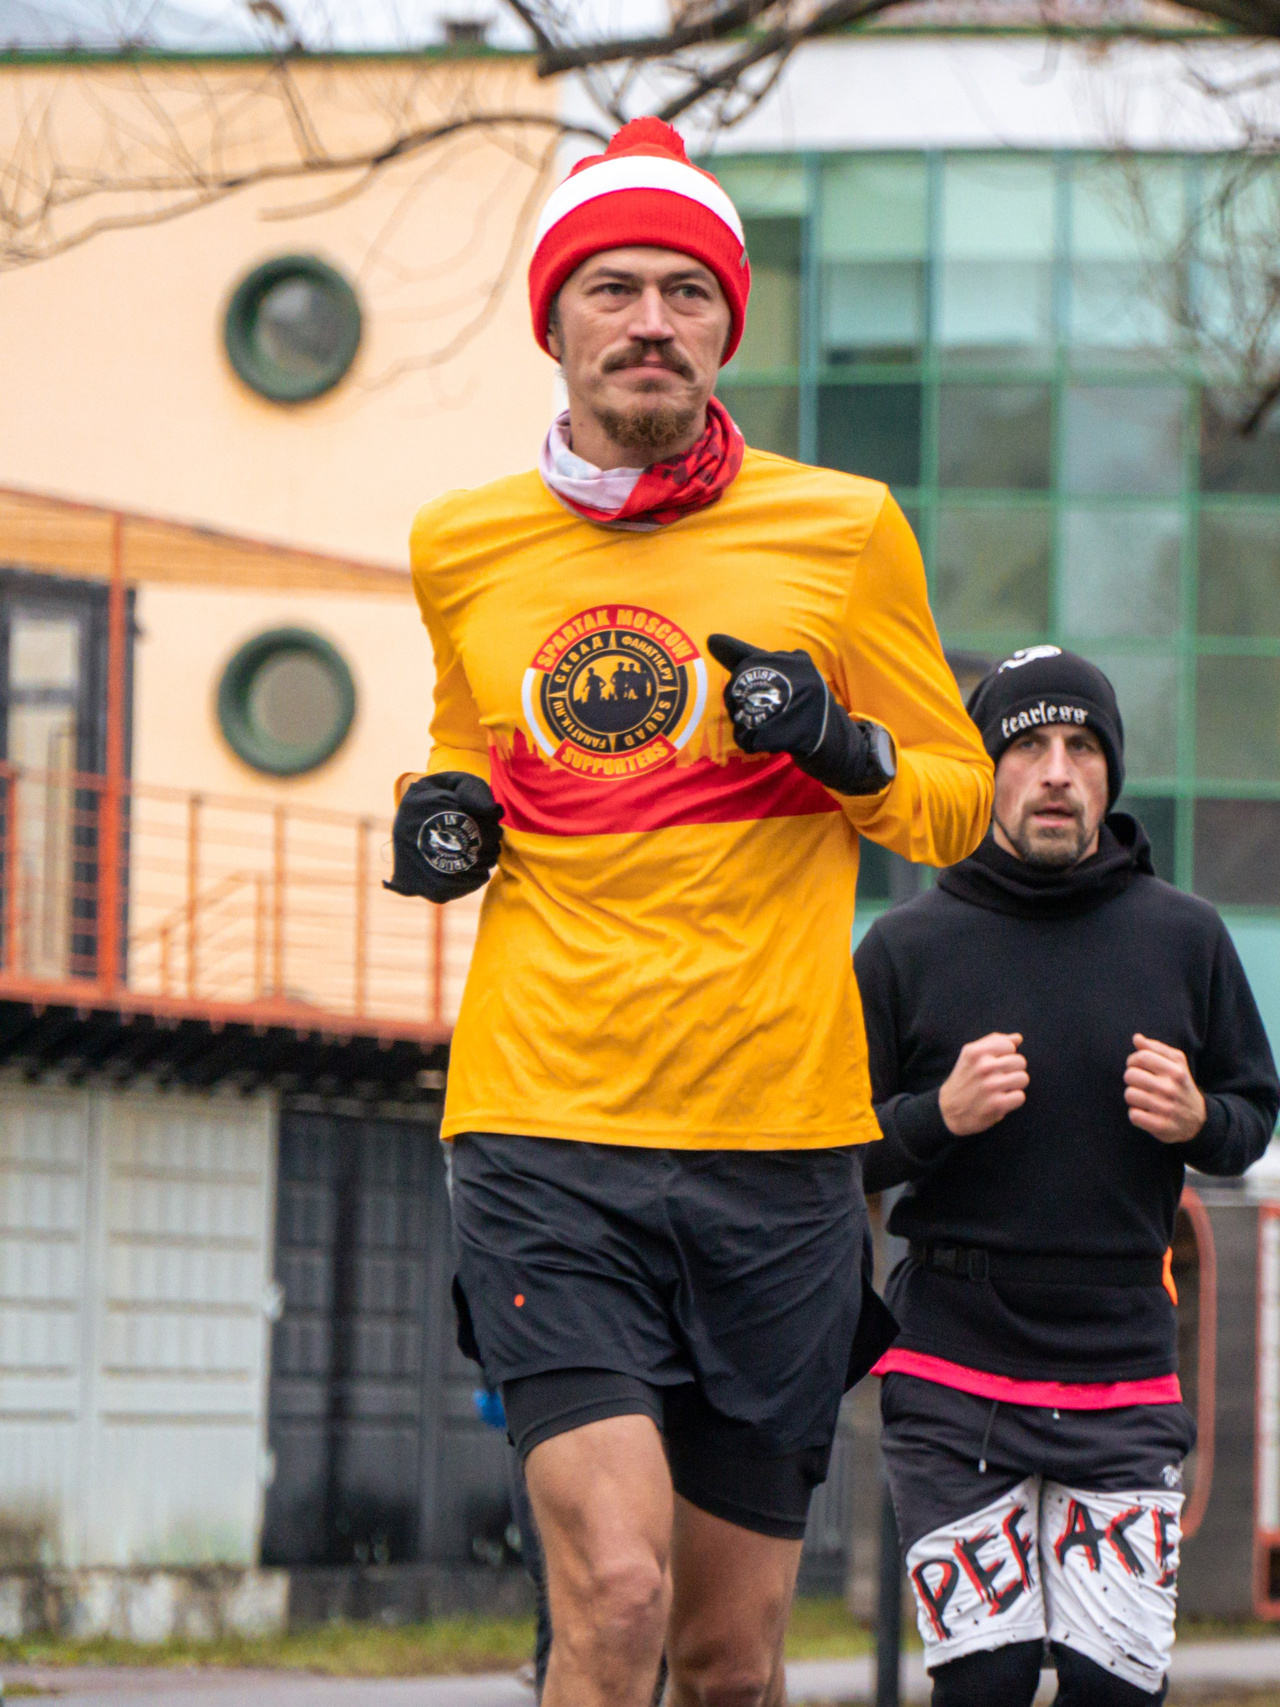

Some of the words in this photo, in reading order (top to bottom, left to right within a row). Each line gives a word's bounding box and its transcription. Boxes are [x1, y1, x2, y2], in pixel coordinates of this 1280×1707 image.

[537, 609, 611, 668] SPARTAK
[616, 609, 694, 660] MOSCOW
[555, 635, 604, 684] СКВАД
[624, 700, 672, 747] SQUAD
[561, 741, 669, 775] SUPPORTERS
